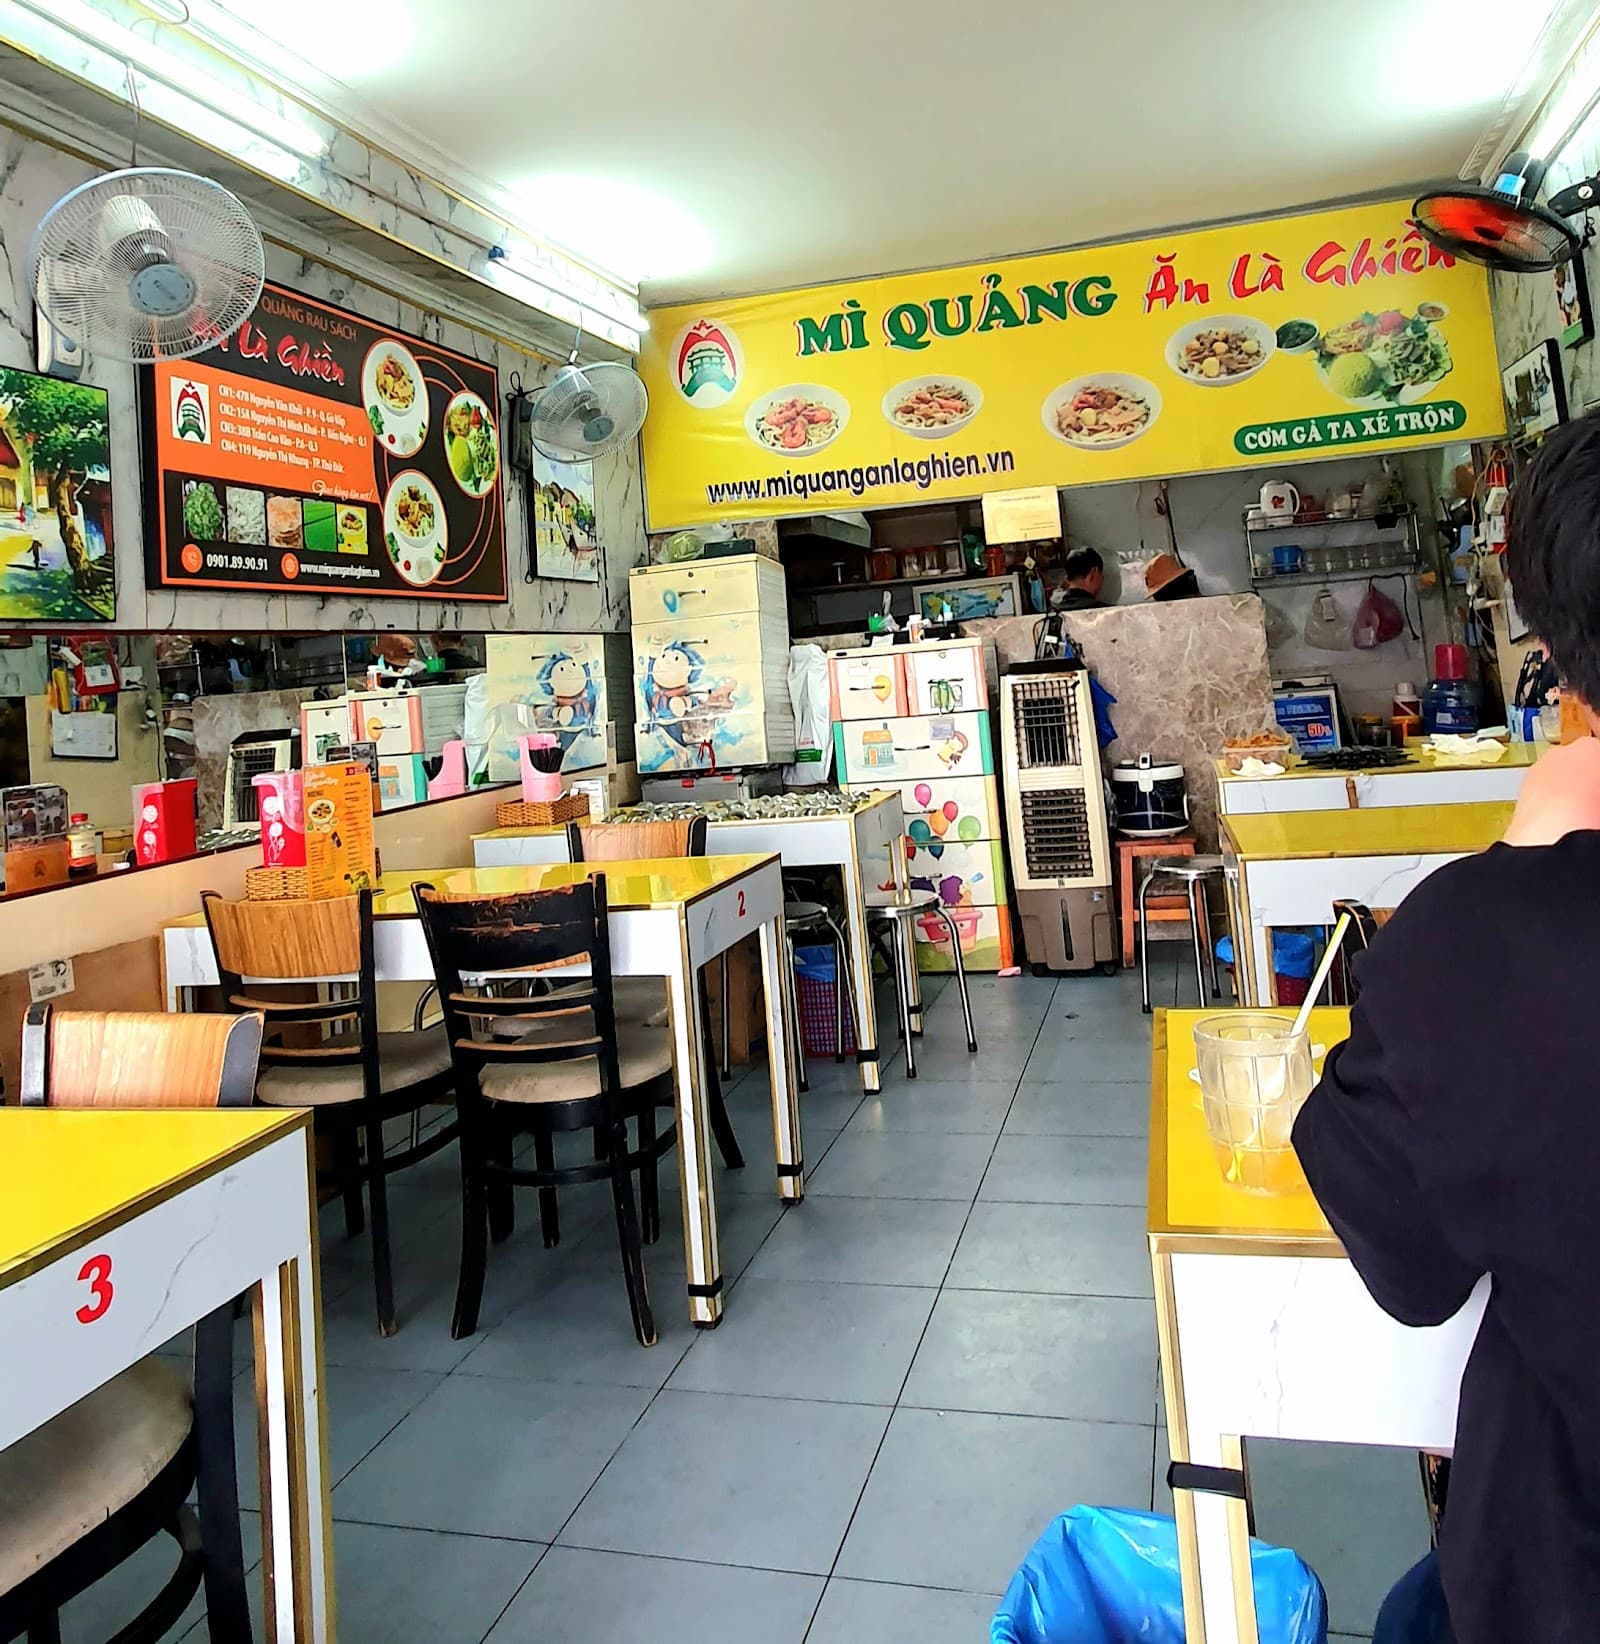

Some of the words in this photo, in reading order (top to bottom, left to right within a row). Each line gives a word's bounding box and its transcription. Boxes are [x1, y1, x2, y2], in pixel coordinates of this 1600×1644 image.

[306, 311, 328, 332] RAU
[796, 299, 870, 358] MÌ
[884, 273, 1118, 352] QUẢNG
[1144, 252, 1209, 314] Ăn
[1230, 252, 1284, 302] Là
[238, 320, 269, 364] Là
[277, 334, 345, 387] Ghiền
[1244, 427, 1287, 451] CƠM
[1292, 416, 1323, 445] GÀ
[1327, 419, 1356, 440] TA
[1361, 410, 1390, 437] XÉ
[1395, 407, 1455, 434] TRỘN
[706, 449, 1015, 504] www.miquanganlaghien.vn
[206, 553, 269, 572] 0901.89.90.91
[737, 890, 747, 918] 2
[75, 1253, 114, 1324] 3
